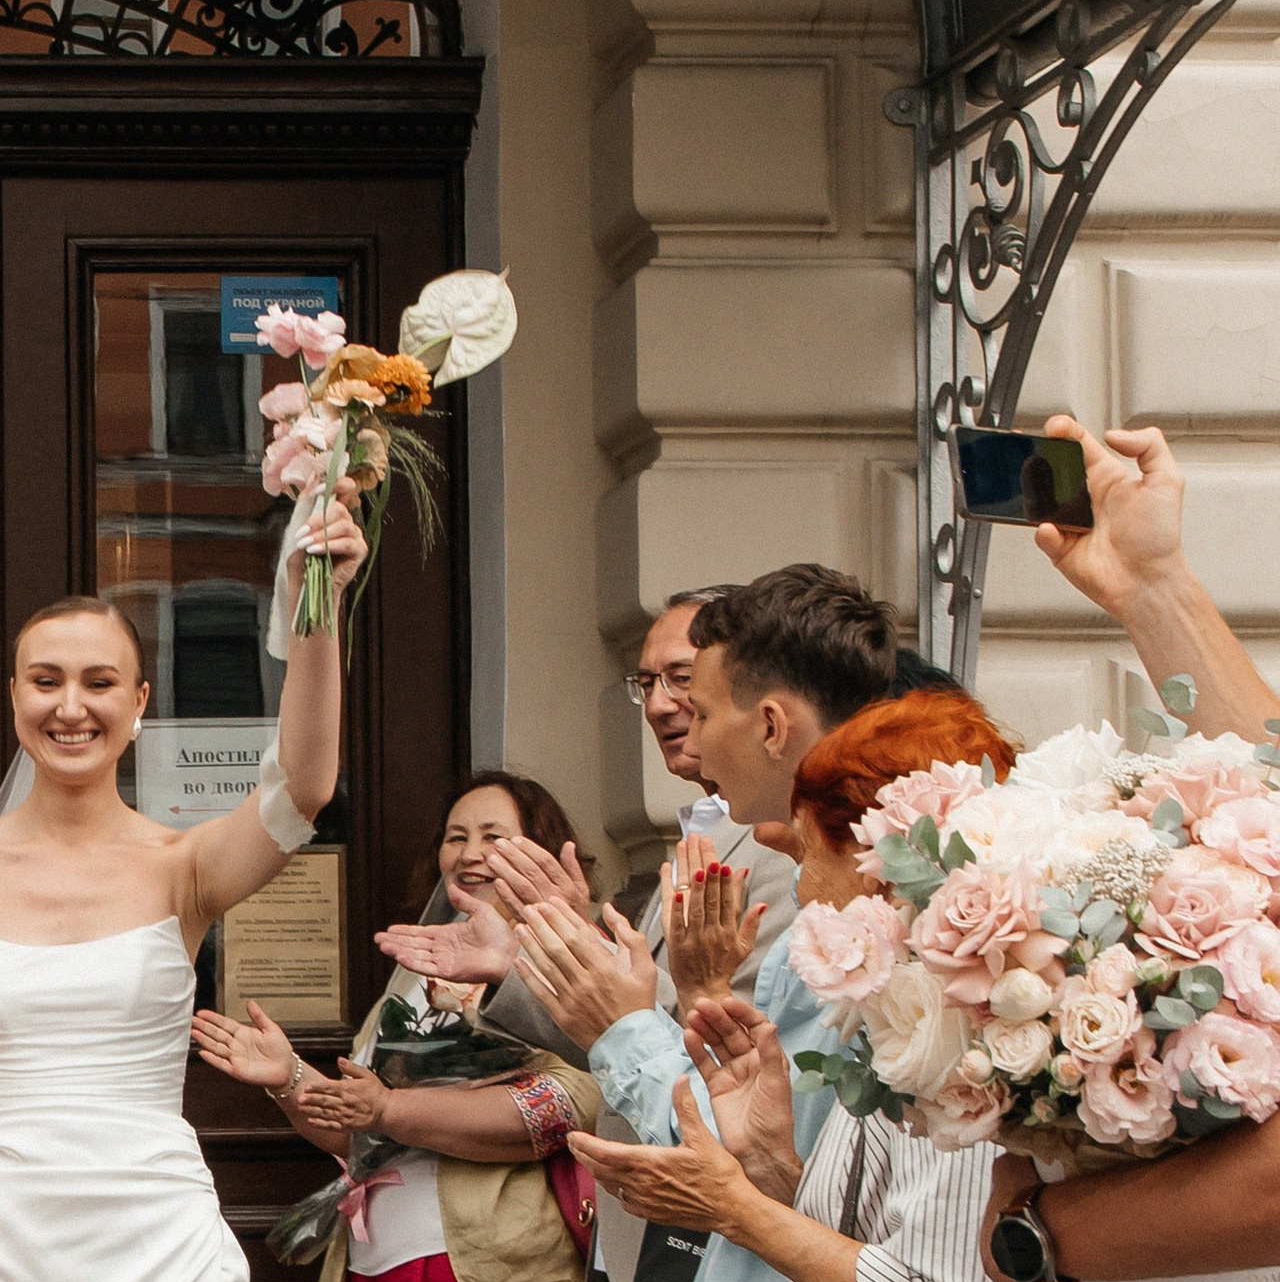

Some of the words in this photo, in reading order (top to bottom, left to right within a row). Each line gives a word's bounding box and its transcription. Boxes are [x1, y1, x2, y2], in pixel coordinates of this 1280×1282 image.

[233, 298, 262, 309] ПОД
[176, 747, 265, 764] Апостил
[183, 782, 205, 794] во
[666, 1235, 693, 1252] SCENT
